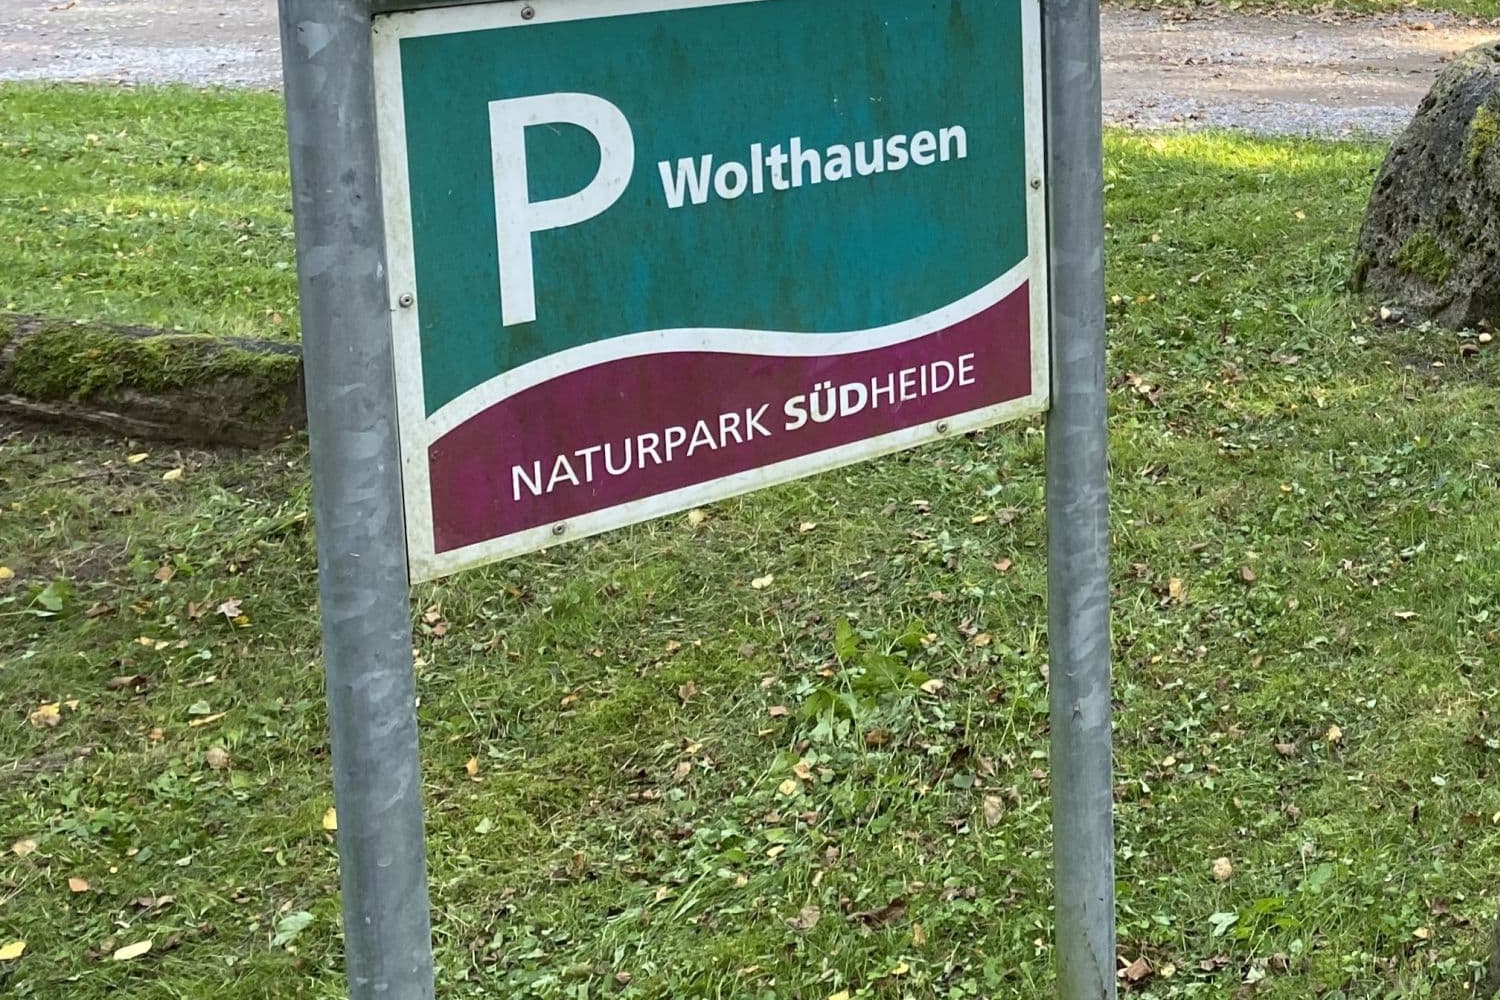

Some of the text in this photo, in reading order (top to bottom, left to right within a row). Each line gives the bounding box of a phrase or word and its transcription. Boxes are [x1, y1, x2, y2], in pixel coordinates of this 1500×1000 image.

[488, 93, 968, 327] P Wolthausen
[510, 352, 976, 501] NATURPARK SÜDHEIDE
